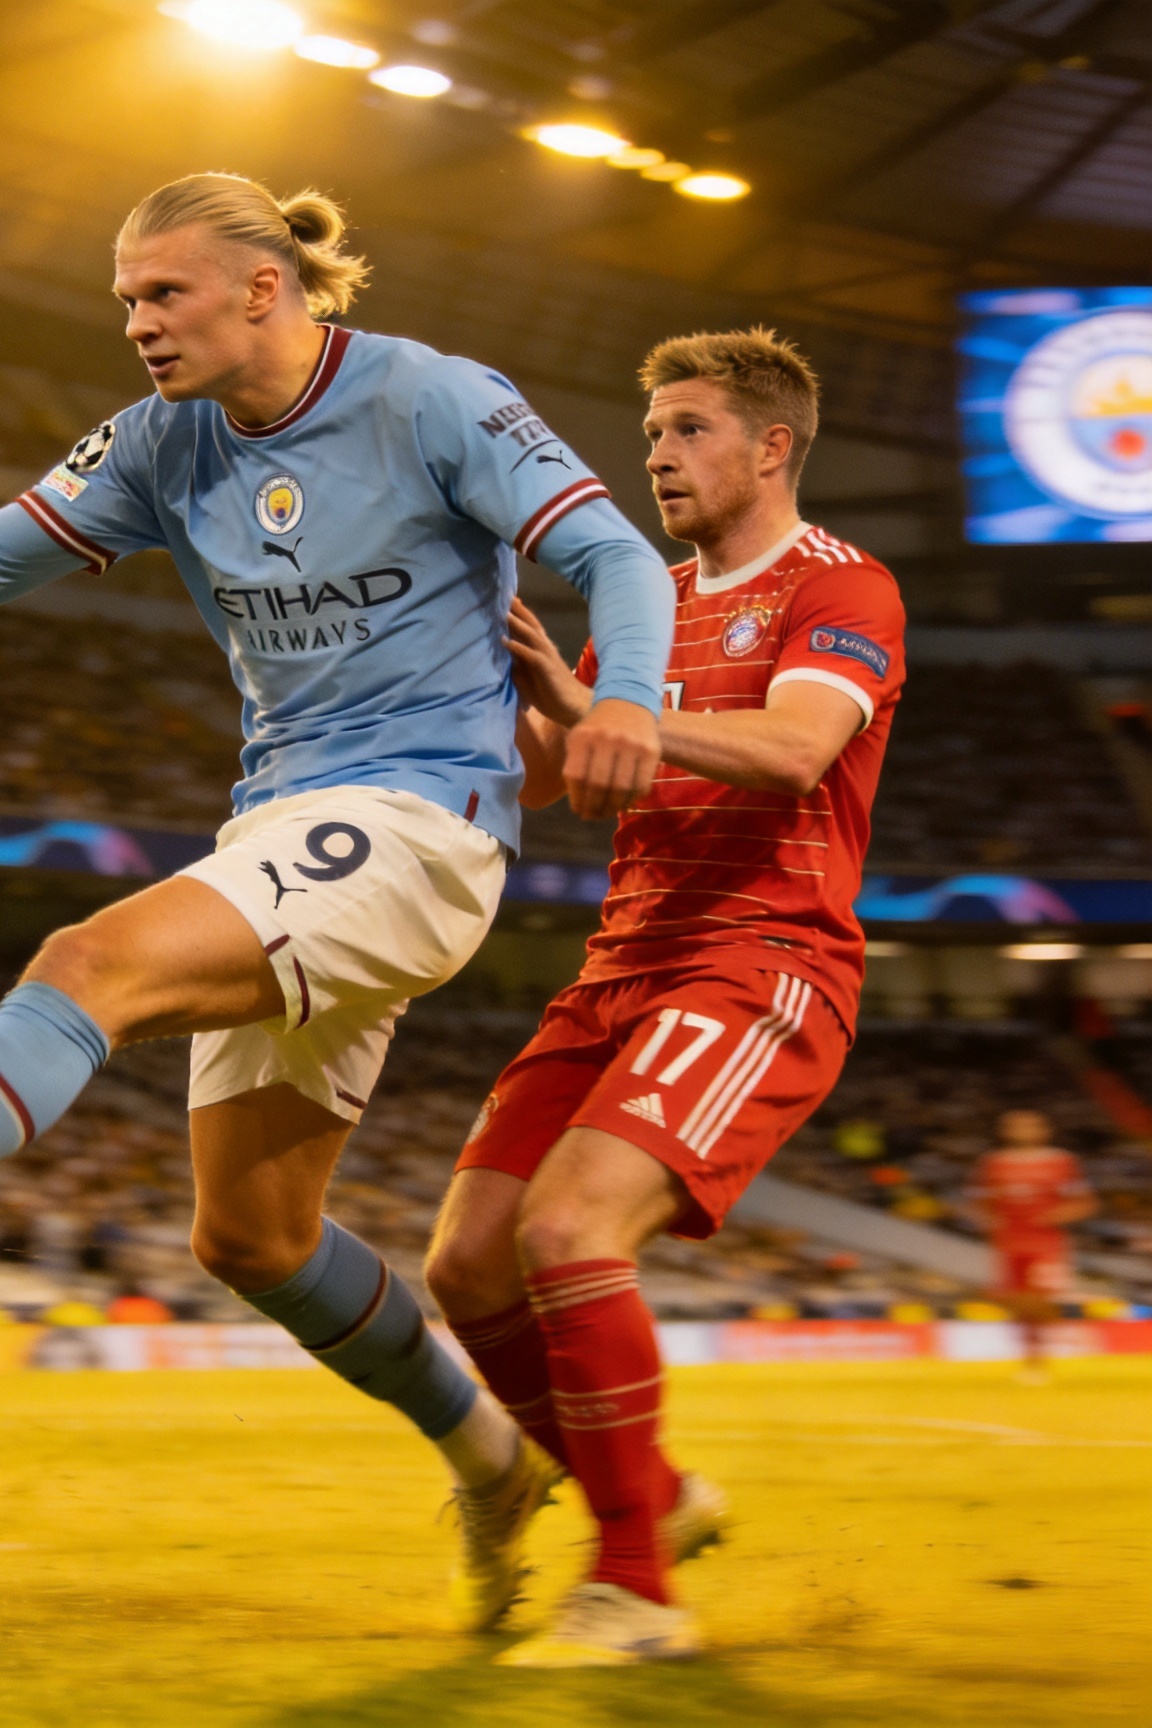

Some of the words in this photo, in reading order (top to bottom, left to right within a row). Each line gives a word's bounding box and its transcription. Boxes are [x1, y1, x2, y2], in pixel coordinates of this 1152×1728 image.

[214, 567, 412, 621] ETIHAD
[292, 821, 372, 882] 9
[630, 1008, 726, 1086] 17
